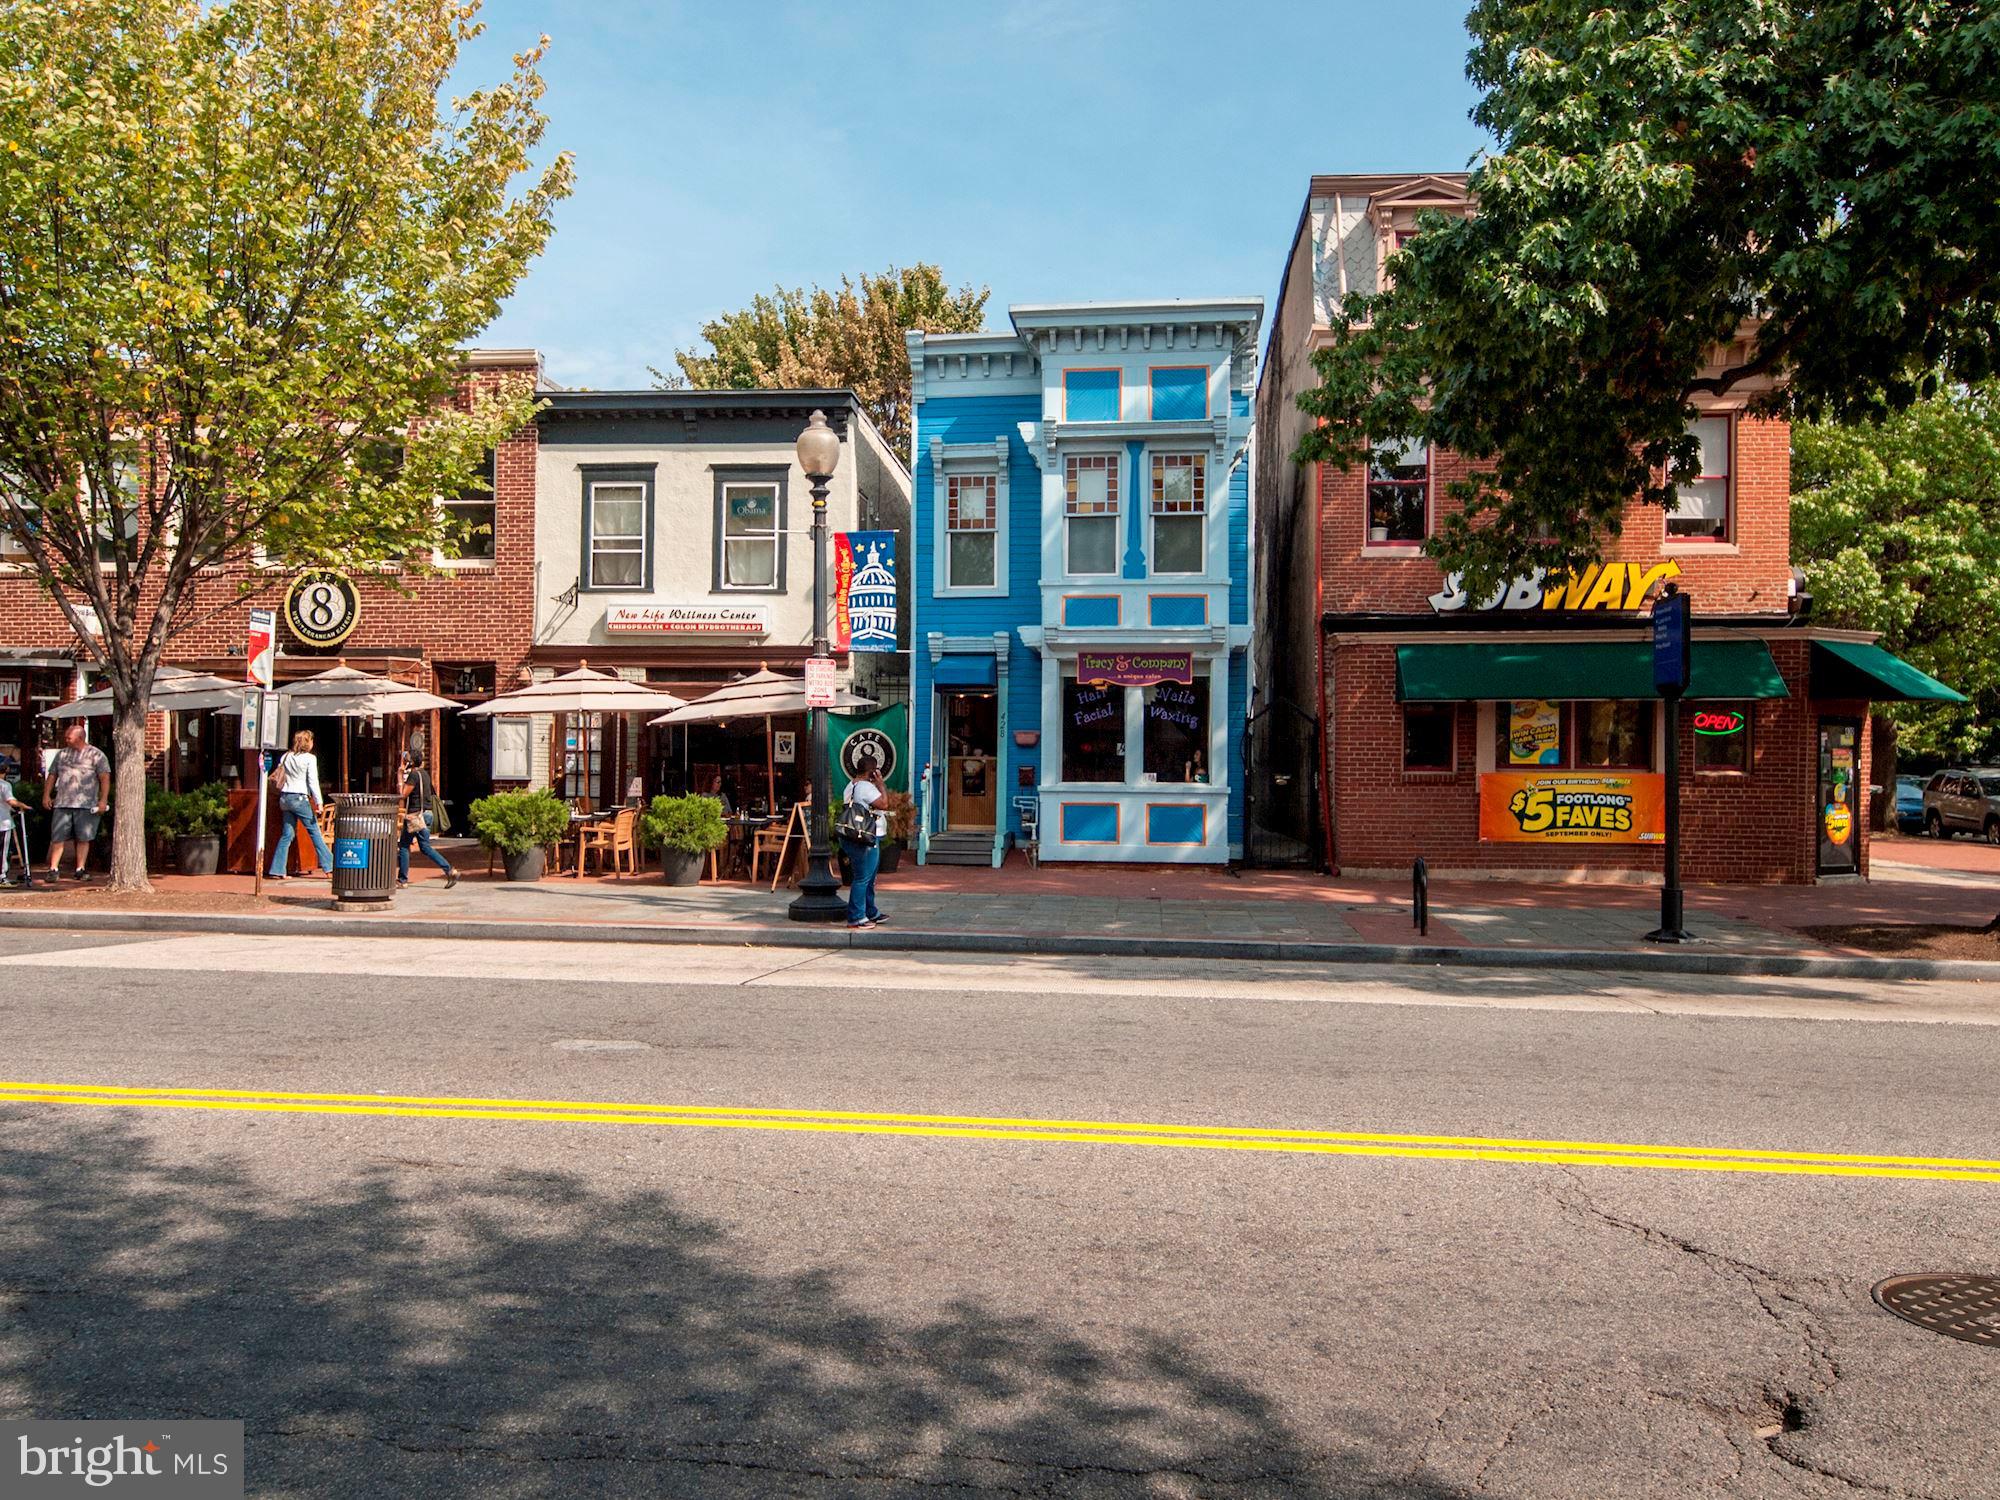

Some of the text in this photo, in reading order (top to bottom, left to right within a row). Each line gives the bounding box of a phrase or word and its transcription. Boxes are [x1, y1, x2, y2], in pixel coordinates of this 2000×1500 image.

[736, 505, 766, 515] Obama
[837, 589, 848, 605] Alive
[311, 587, 332, 625] 8
[615, 609, 757, 622] New Life Wellness Center
[292, 610, 336, 639] MEDITERRANEAN
[335, 611, 353, 634] EATERY
[1083, 655, 1187, 671] Tracy & Company
[458, 673, 476, 685] 424
[1077, 689, 1108, 704] Hair
[1157, 687, 1196, 704] Nails
[1074, 702, 1114, 725] Facial
[1150, 706, 1200, 729] Waxing
[1694, 713, 1738, 729] OPEN
[850, 733, 880, 746] CAFE
[1510, 790, 1554, 831] $5
[1556, 806, 1630, 830] FAVES
[1639, 832, 1665, 840] SUBWA
